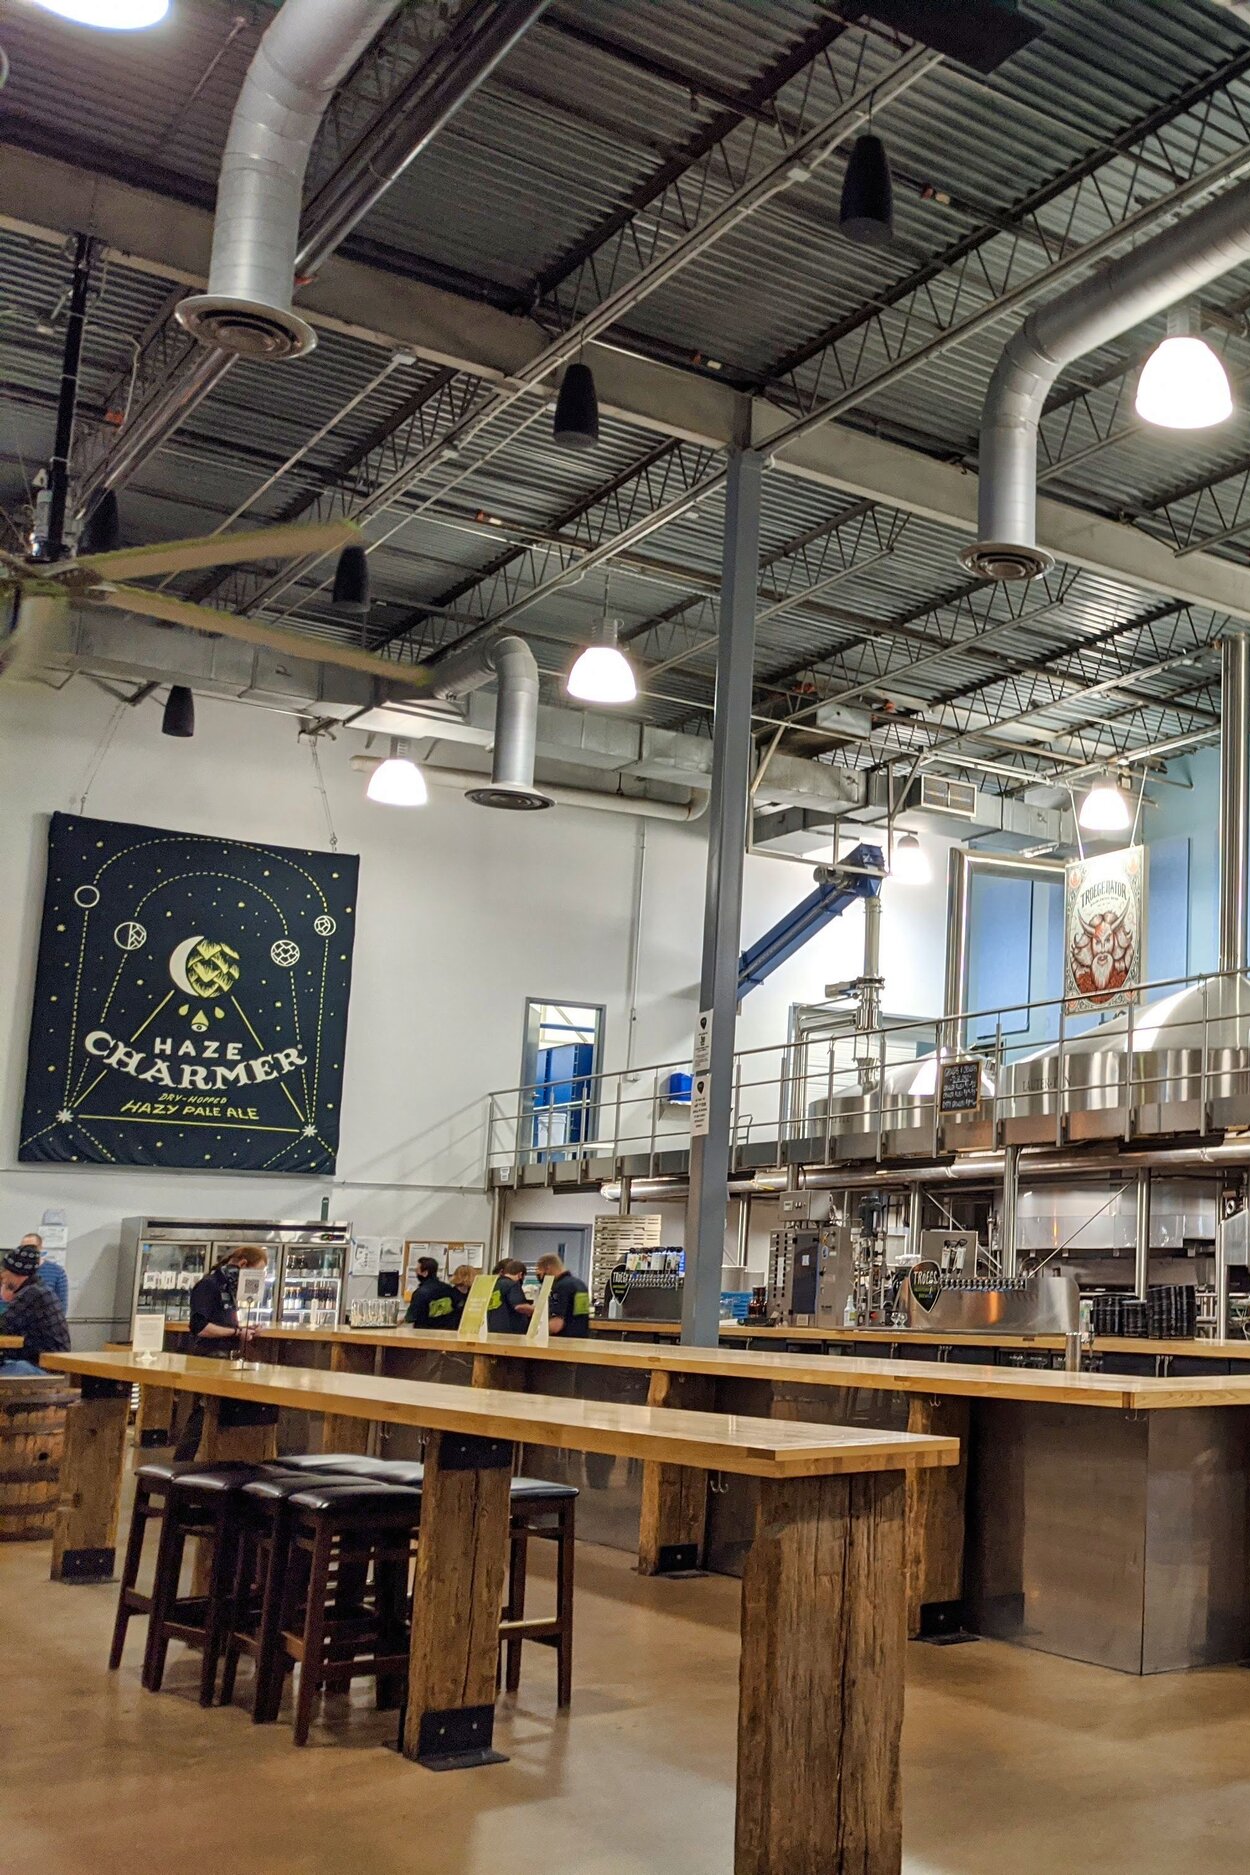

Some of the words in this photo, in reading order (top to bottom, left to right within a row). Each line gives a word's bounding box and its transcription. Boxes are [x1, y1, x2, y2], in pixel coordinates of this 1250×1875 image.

[154, 1036, 244, 1060] HAZE
[84, 1030, 308, 1090] CHARMER
[158, 1092, 228, 1104] DRY-HOPPED
[120, 1099, 179, 1114] HAZY
[182, 1106, 221, 1117] PALE
[226, 1107, 260, 1120] ALE
